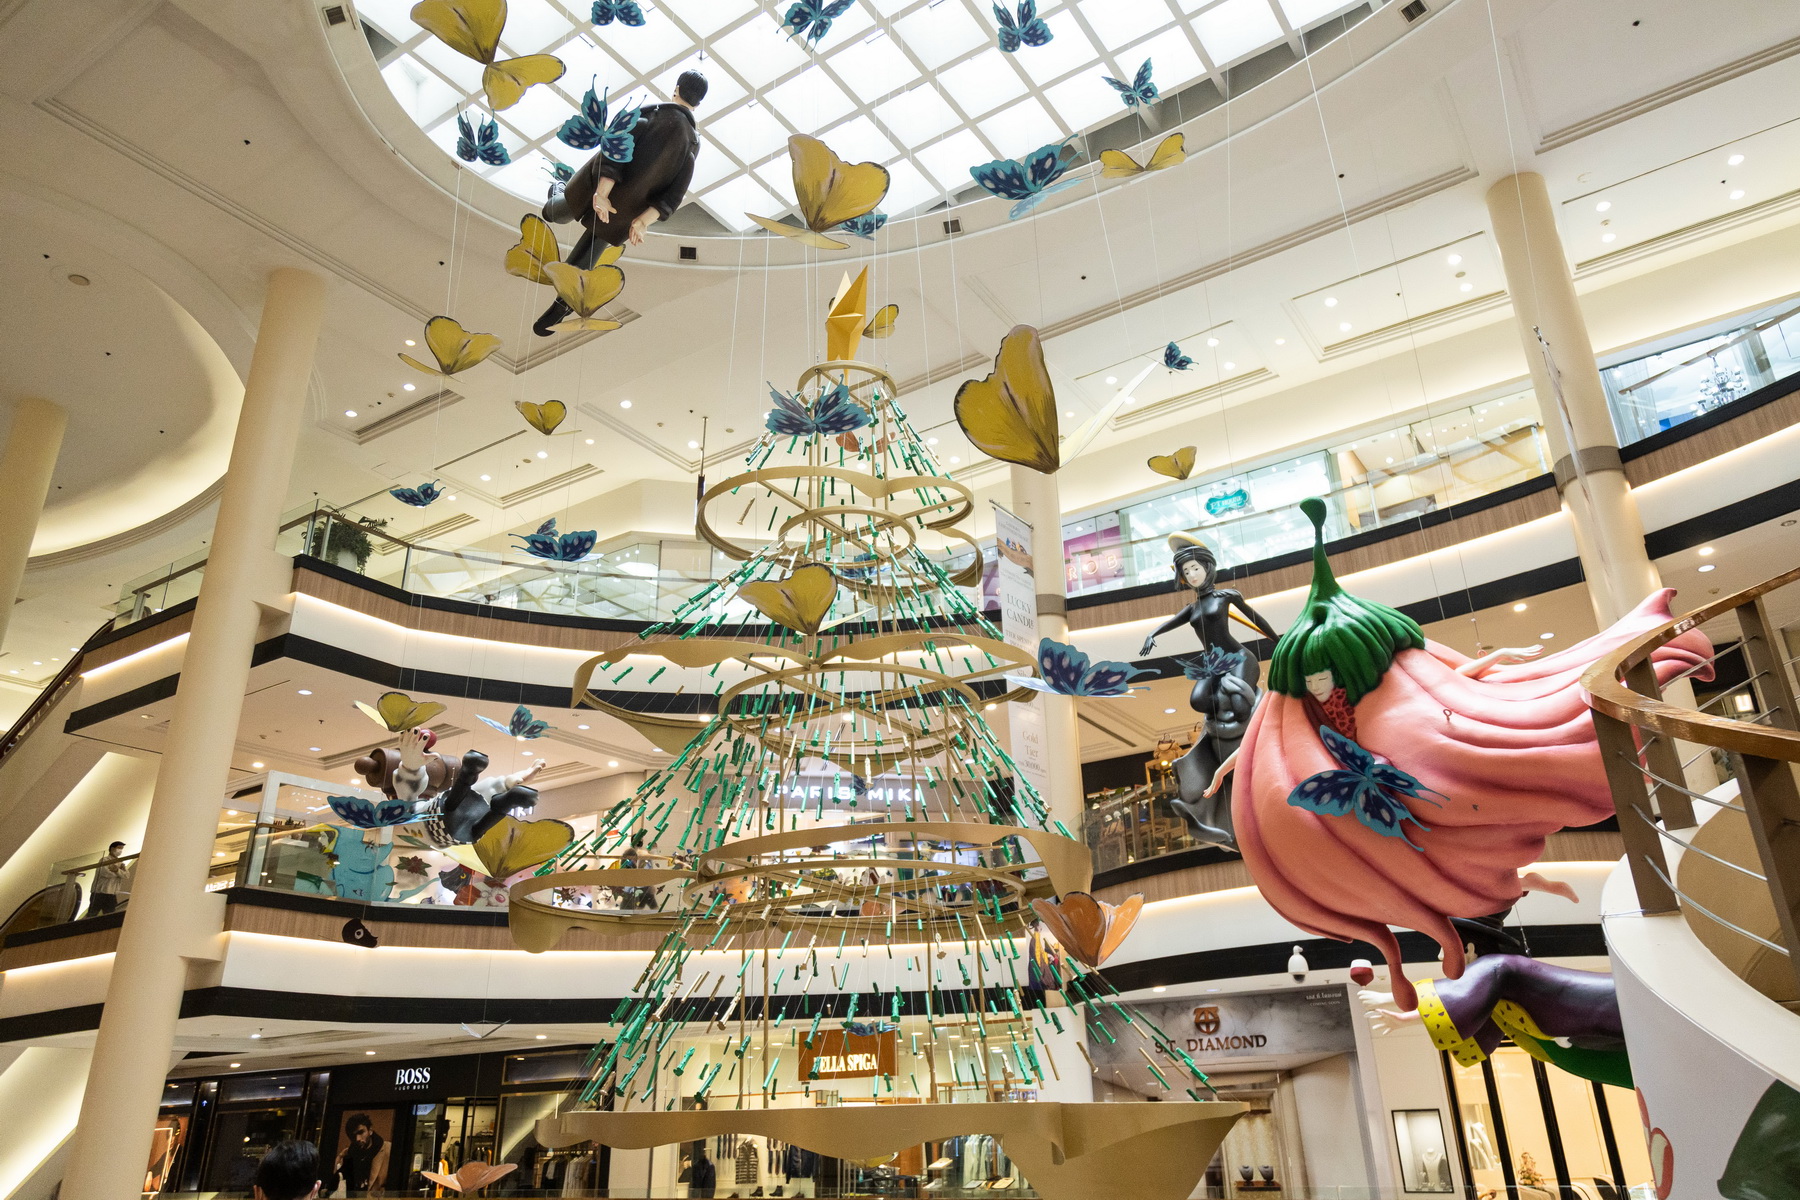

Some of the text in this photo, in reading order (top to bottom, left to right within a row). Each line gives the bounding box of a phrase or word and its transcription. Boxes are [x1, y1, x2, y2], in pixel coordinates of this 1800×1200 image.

[1007, 593, 1032, 615] LUCKY
[1022, 731, 1039, 745] Gold
[1024, 744, 1039, 758] Tier
[867, 787, 921, 802] MIKI
[1186, 1034, 1268, 1053] DIAMOND
[813, 1053, 878, 1073] ELLA SPIGA
[395, 1067, 431, 1085] BOSS
